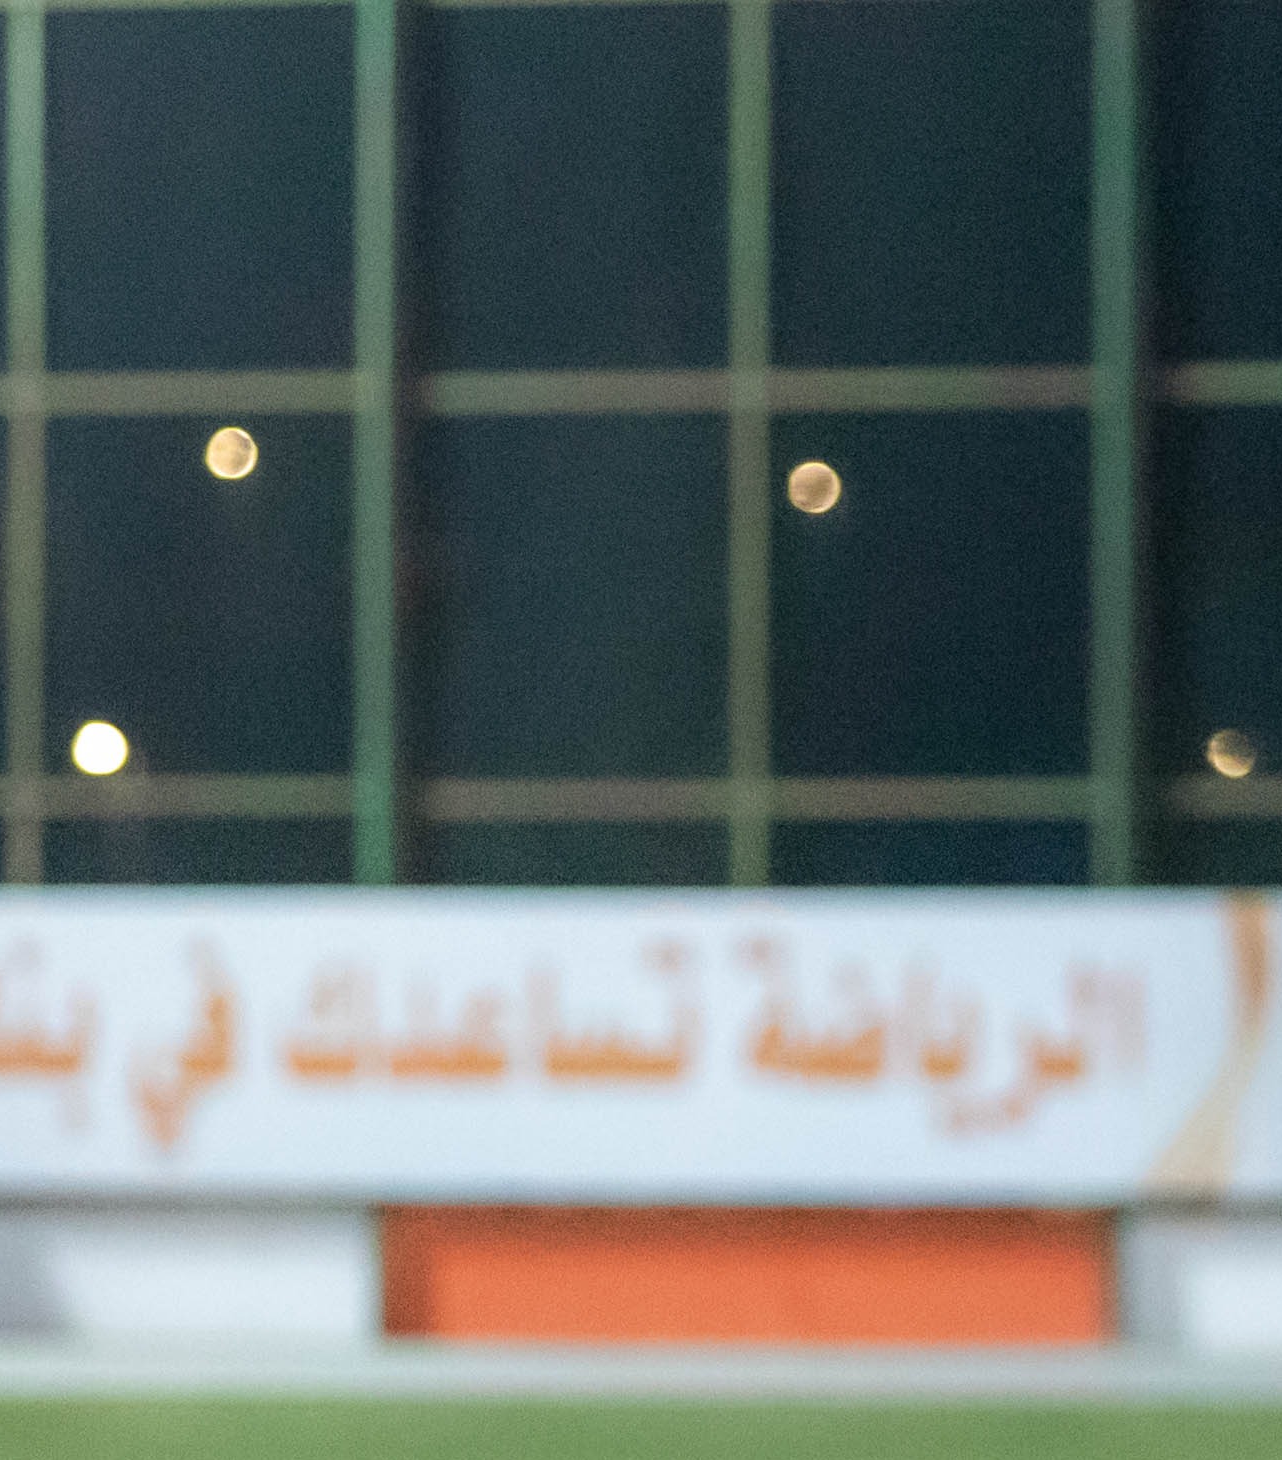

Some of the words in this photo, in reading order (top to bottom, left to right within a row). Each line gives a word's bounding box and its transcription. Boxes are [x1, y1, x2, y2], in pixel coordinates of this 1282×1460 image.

[128, 934, 237, 1152] في
[282, 934, 701, 1086] تساعدك
[740, 932, 1147, 1138] الرياضة
